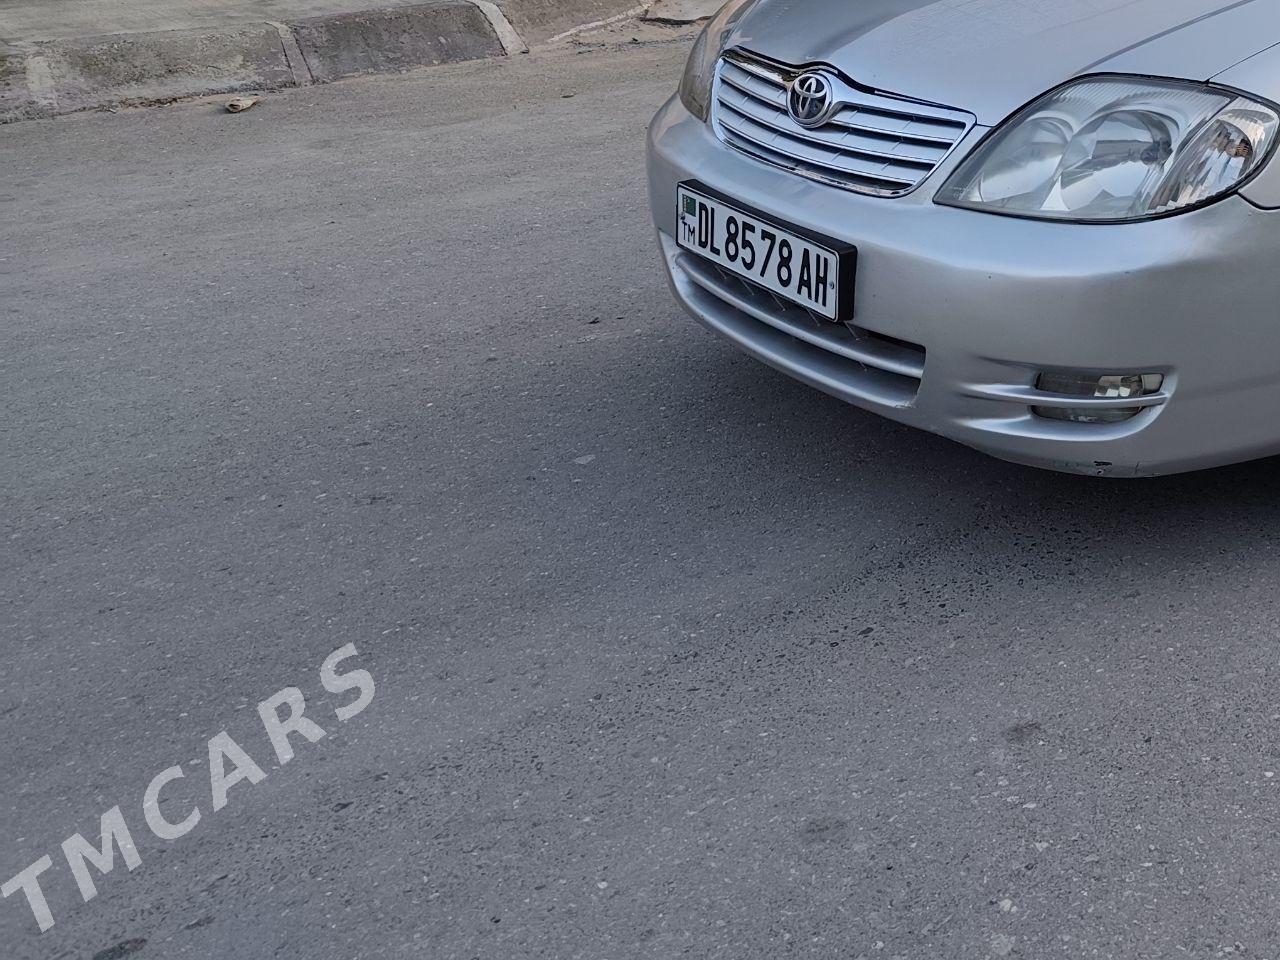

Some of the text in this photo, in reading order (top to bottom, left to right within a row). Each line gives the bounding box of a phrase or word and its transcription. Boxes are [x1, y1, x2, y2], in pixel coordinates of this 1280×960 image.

[681, 221, 696, 245] TM
[698, 201, 829, 307] DL 8578 AH
